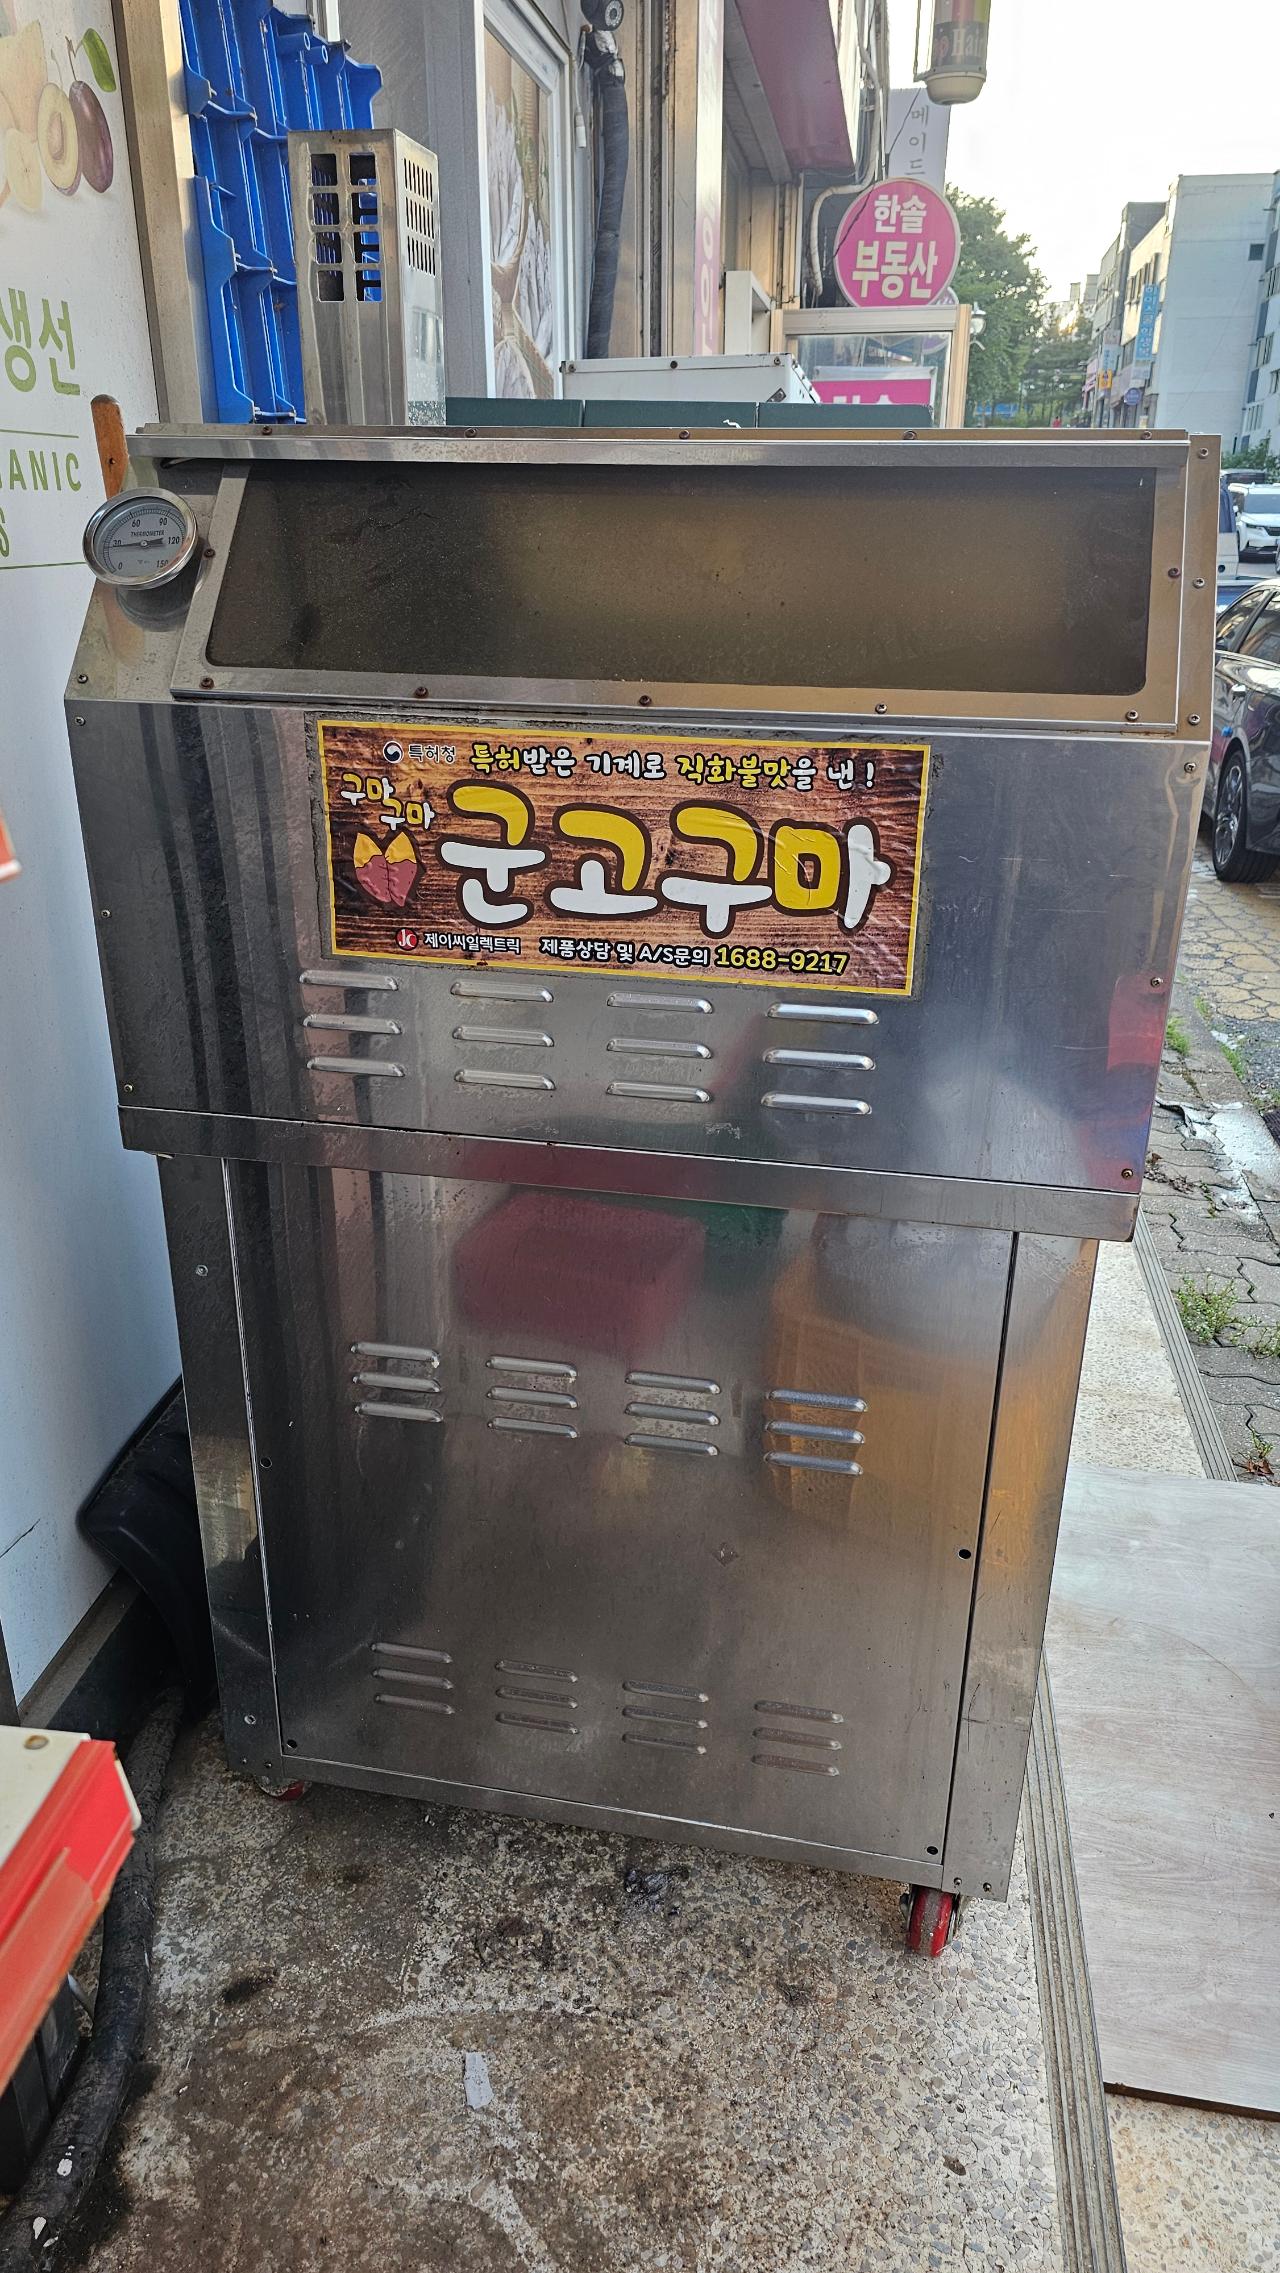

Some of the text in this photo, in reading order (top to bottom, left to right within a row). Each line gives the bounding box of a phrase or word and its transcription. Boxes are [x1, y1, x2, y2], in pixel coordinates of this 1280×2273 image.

[874, 194, 927, 234] 한솔
[852, 240, 938, 299] 부동산
[0, 288, 80, 395] 생선
[0, 448, 82, 492] ANIC
[131, 517, 168, 528] 60 90
[168, 536, 180, 545] 120
[118, 562, 123, 570] 0
[156, 559, 169, 568] 150
[408, 744, 456, 763] 특허청
[470, 743, 576, 777] 특허받은
[586, 751, 666, 779] 기계로
[676, 754, 818, 790] 직화불맛을
[829, 760, 854, 789] 낸
[439, 784, 892, 934] 군고구마
[424, 932, 848, 974] 제이씨일렉트릭 제품상담 및 A/S문의 1688-9217
